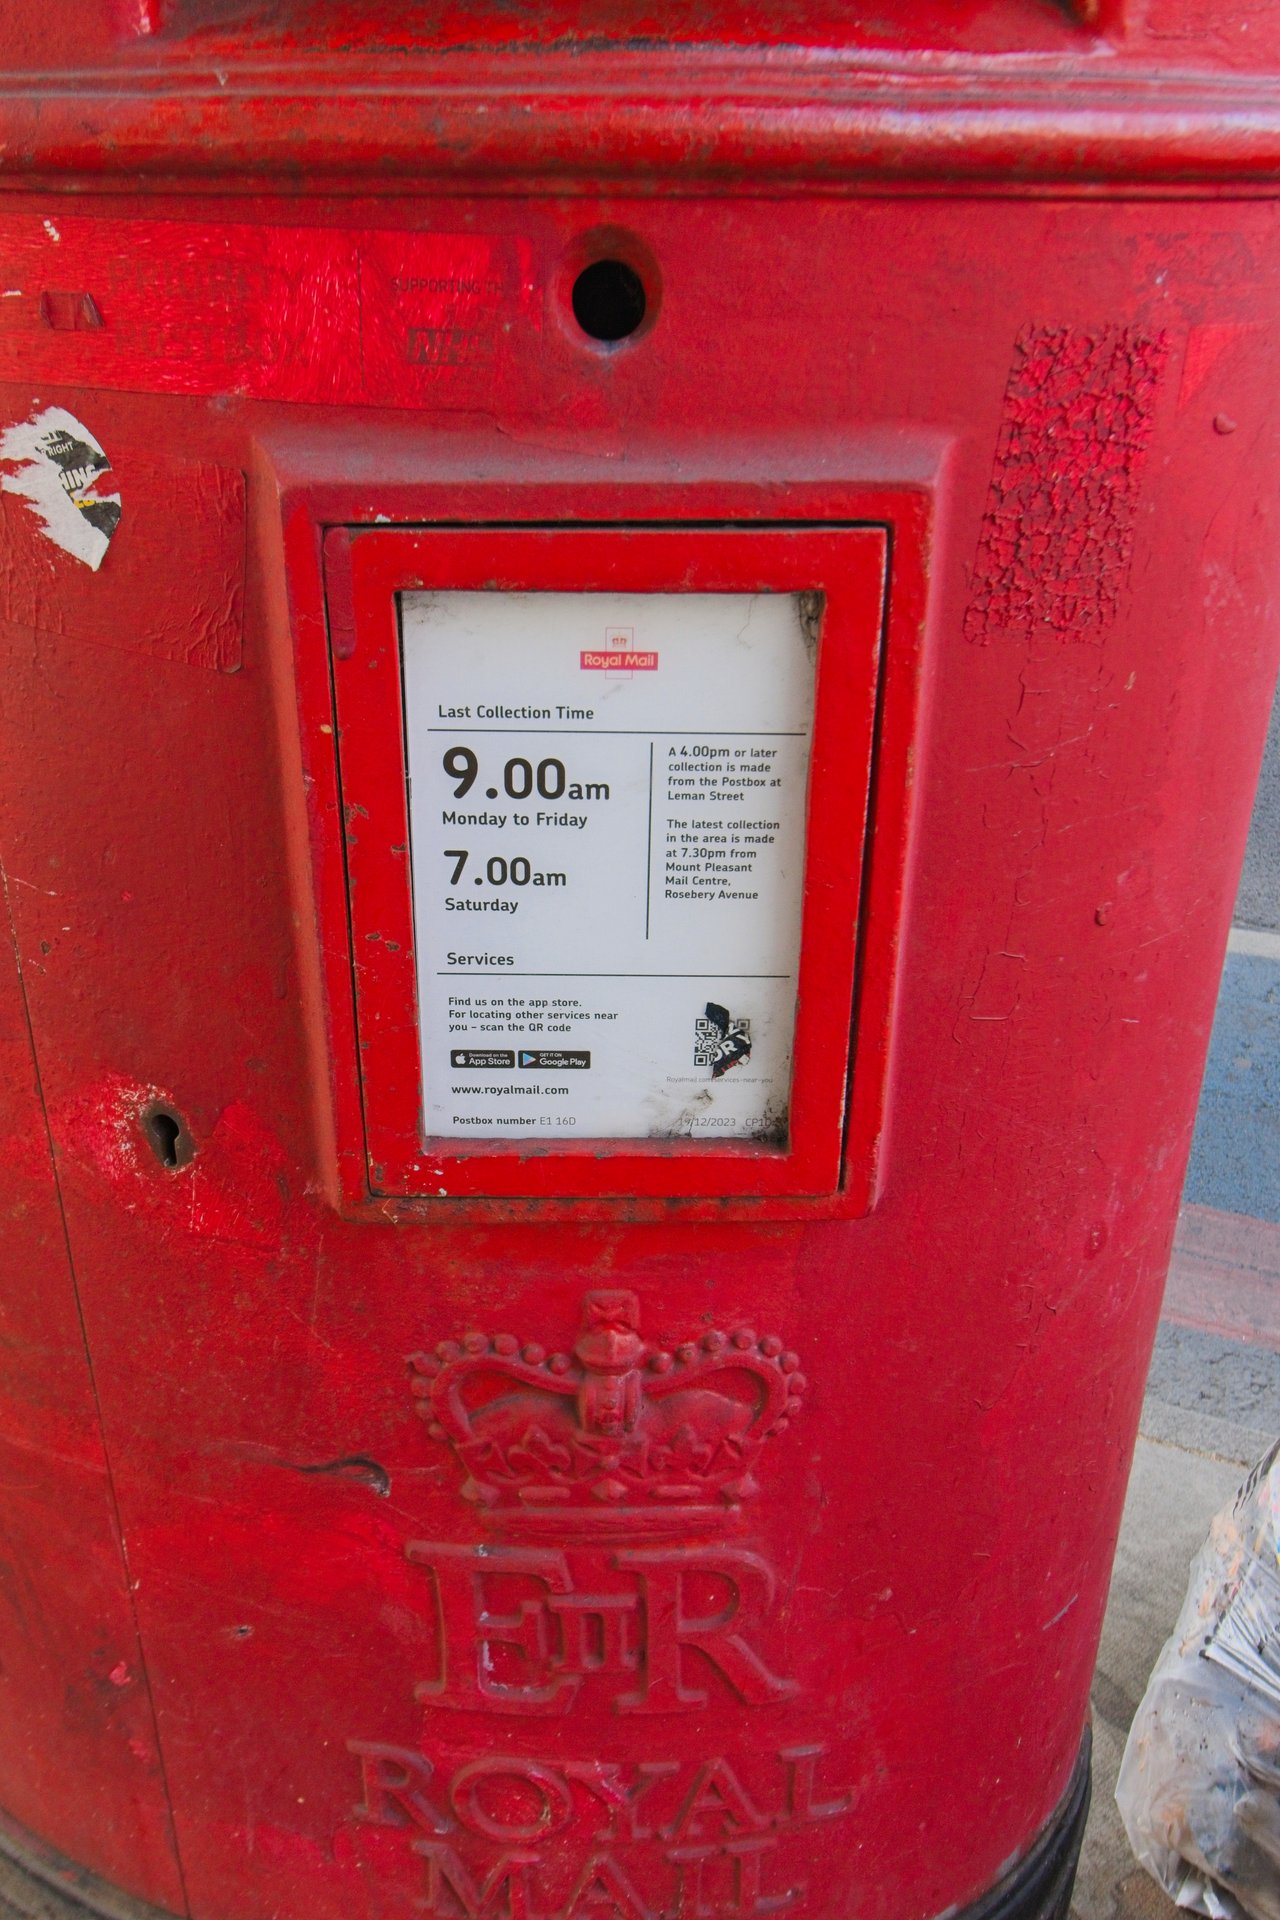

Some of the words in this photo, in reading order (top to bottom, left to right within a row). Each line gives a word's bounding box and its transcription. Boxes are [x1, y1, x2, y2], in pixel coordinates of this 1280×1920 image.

[584, 653, 622, 668] Royal
[624, 654, 655, 666] Mail
[438, 705, 471, 718] Last
[476, 705, 550, 719] Collection
[555, 706, 594, 719] Time
[668, 747, 676, 756] A
[679, 746, 729, 759] 4.00pm
[749, 748, 778, 758] later
[668, 762, 722, 772] collection
[726, 762, 736, 772] is
[739, 763, 771, 772] made
[442, 747, 609, 800] 9.00am
[667, 776, 695, 786] from
[698, 777, 717, 786] the
[721, 777, 766, 786] Postbox
[769, 778, 781, 787] at
[667, 791, 705, 800] Leman
[709, 791, 744, 801] Street
[442, 811, 507, 828] Monday
[512, 813, 529, 825] to
[536, 812, 587, 829] Friday
[666, 819, 687, 828] The
[691, 820, 723, 829] latest
[726, 820, 780, 829] collection
[666, 833, 676, 842] in
[678, 834, 697, 842] the
[730, 834, 740, 843] is
[743, 834, 775, 843] made
[665, 849, 677, 857] at
[680, 848, 726, 860] 7.30pm
[729, 849, 756, 858] from
[443, 850, 566, 886] 7.00am
[665, 862, 701, 871] Mount
[704, 863, 752, 872] Pleasant
[665, 876, 688, 885] Mail
[691, 876, 730, 886] Centre,
[664, 890, 715, 901] Rosebery
[717, 890, 758, 899] Avenue
[444, 898, 518, 914] Saturday
[446, 952, 514, 965] Services
[448, 997, 471, 1006] Find
[507, 998, 525, 1006] the
[528, 1000, 548, 1008] app
[551, 999, 581, 1007] store.
[448, 1010, 466, 1018] For
[469, 1010, 511, 1020] locating
[515, 1011, 544, 1019] other
[547, 1011, 590, 1019] services
[448, 1024, 467, 1032] you
[507, 1023, 524, 1031] the
[528, 1023, 543, 1031] QR
[546, 1024, 571, 1032] code
[469, 1058, 487, 1066] App
[488, 1058, 511, 1066] Store
[540, 1058, 569, 1067] Google
[570, 1059, 587, 1067] Play
[450, 1085, 568, 1096] www.royalmail.com
[452, 1116, 492, 1124] Postbox
[496, 1117, 536, 1125] number
[539, 1116, 552, 1125] E1
[555, 1116, 577, 1126] 16D
[346, 1738, 858, 1843] ROYAL
[411, 1836, 806, 1920] MAIL
